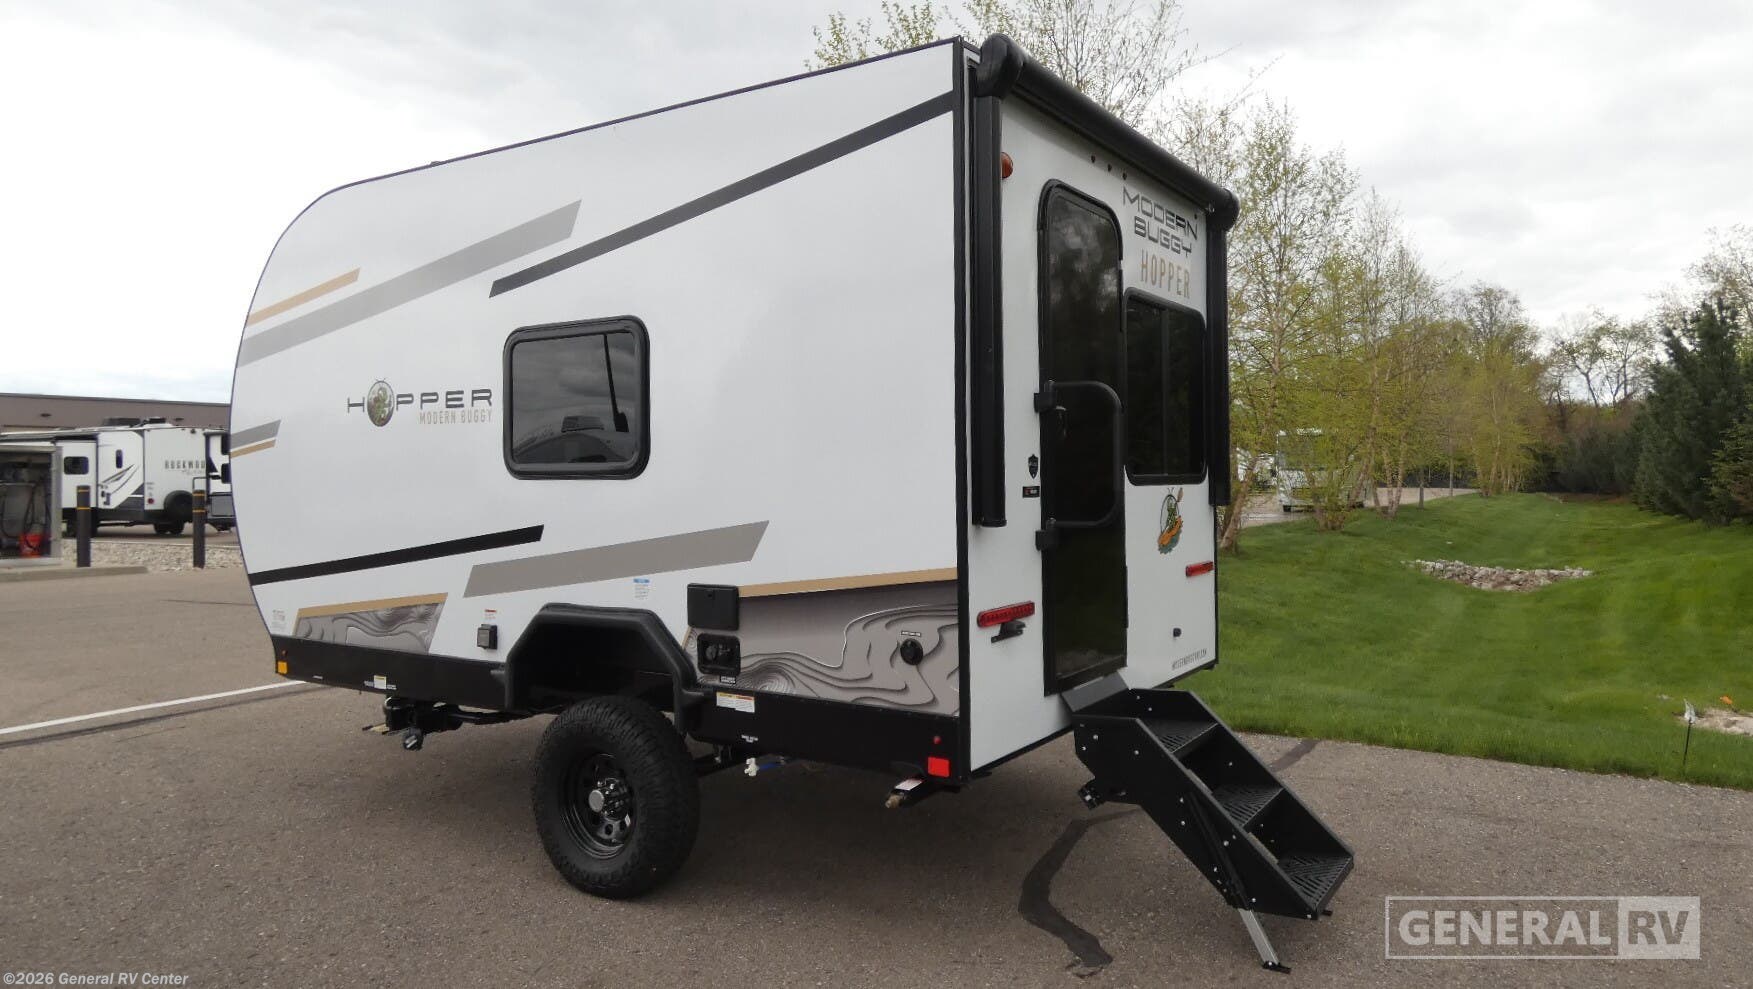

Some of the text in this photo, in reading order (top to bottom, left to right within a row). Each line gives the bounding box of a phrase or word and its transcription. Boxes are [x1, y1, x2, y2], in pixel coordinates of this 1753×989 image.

[1122, 186, 1198, 240] MODERN
[1134, 215, 1192, 258] BUGGY
[1140, 248, 1190, 299] HOPPER
[419, 409, 493, 425] MODERN BUGGY
